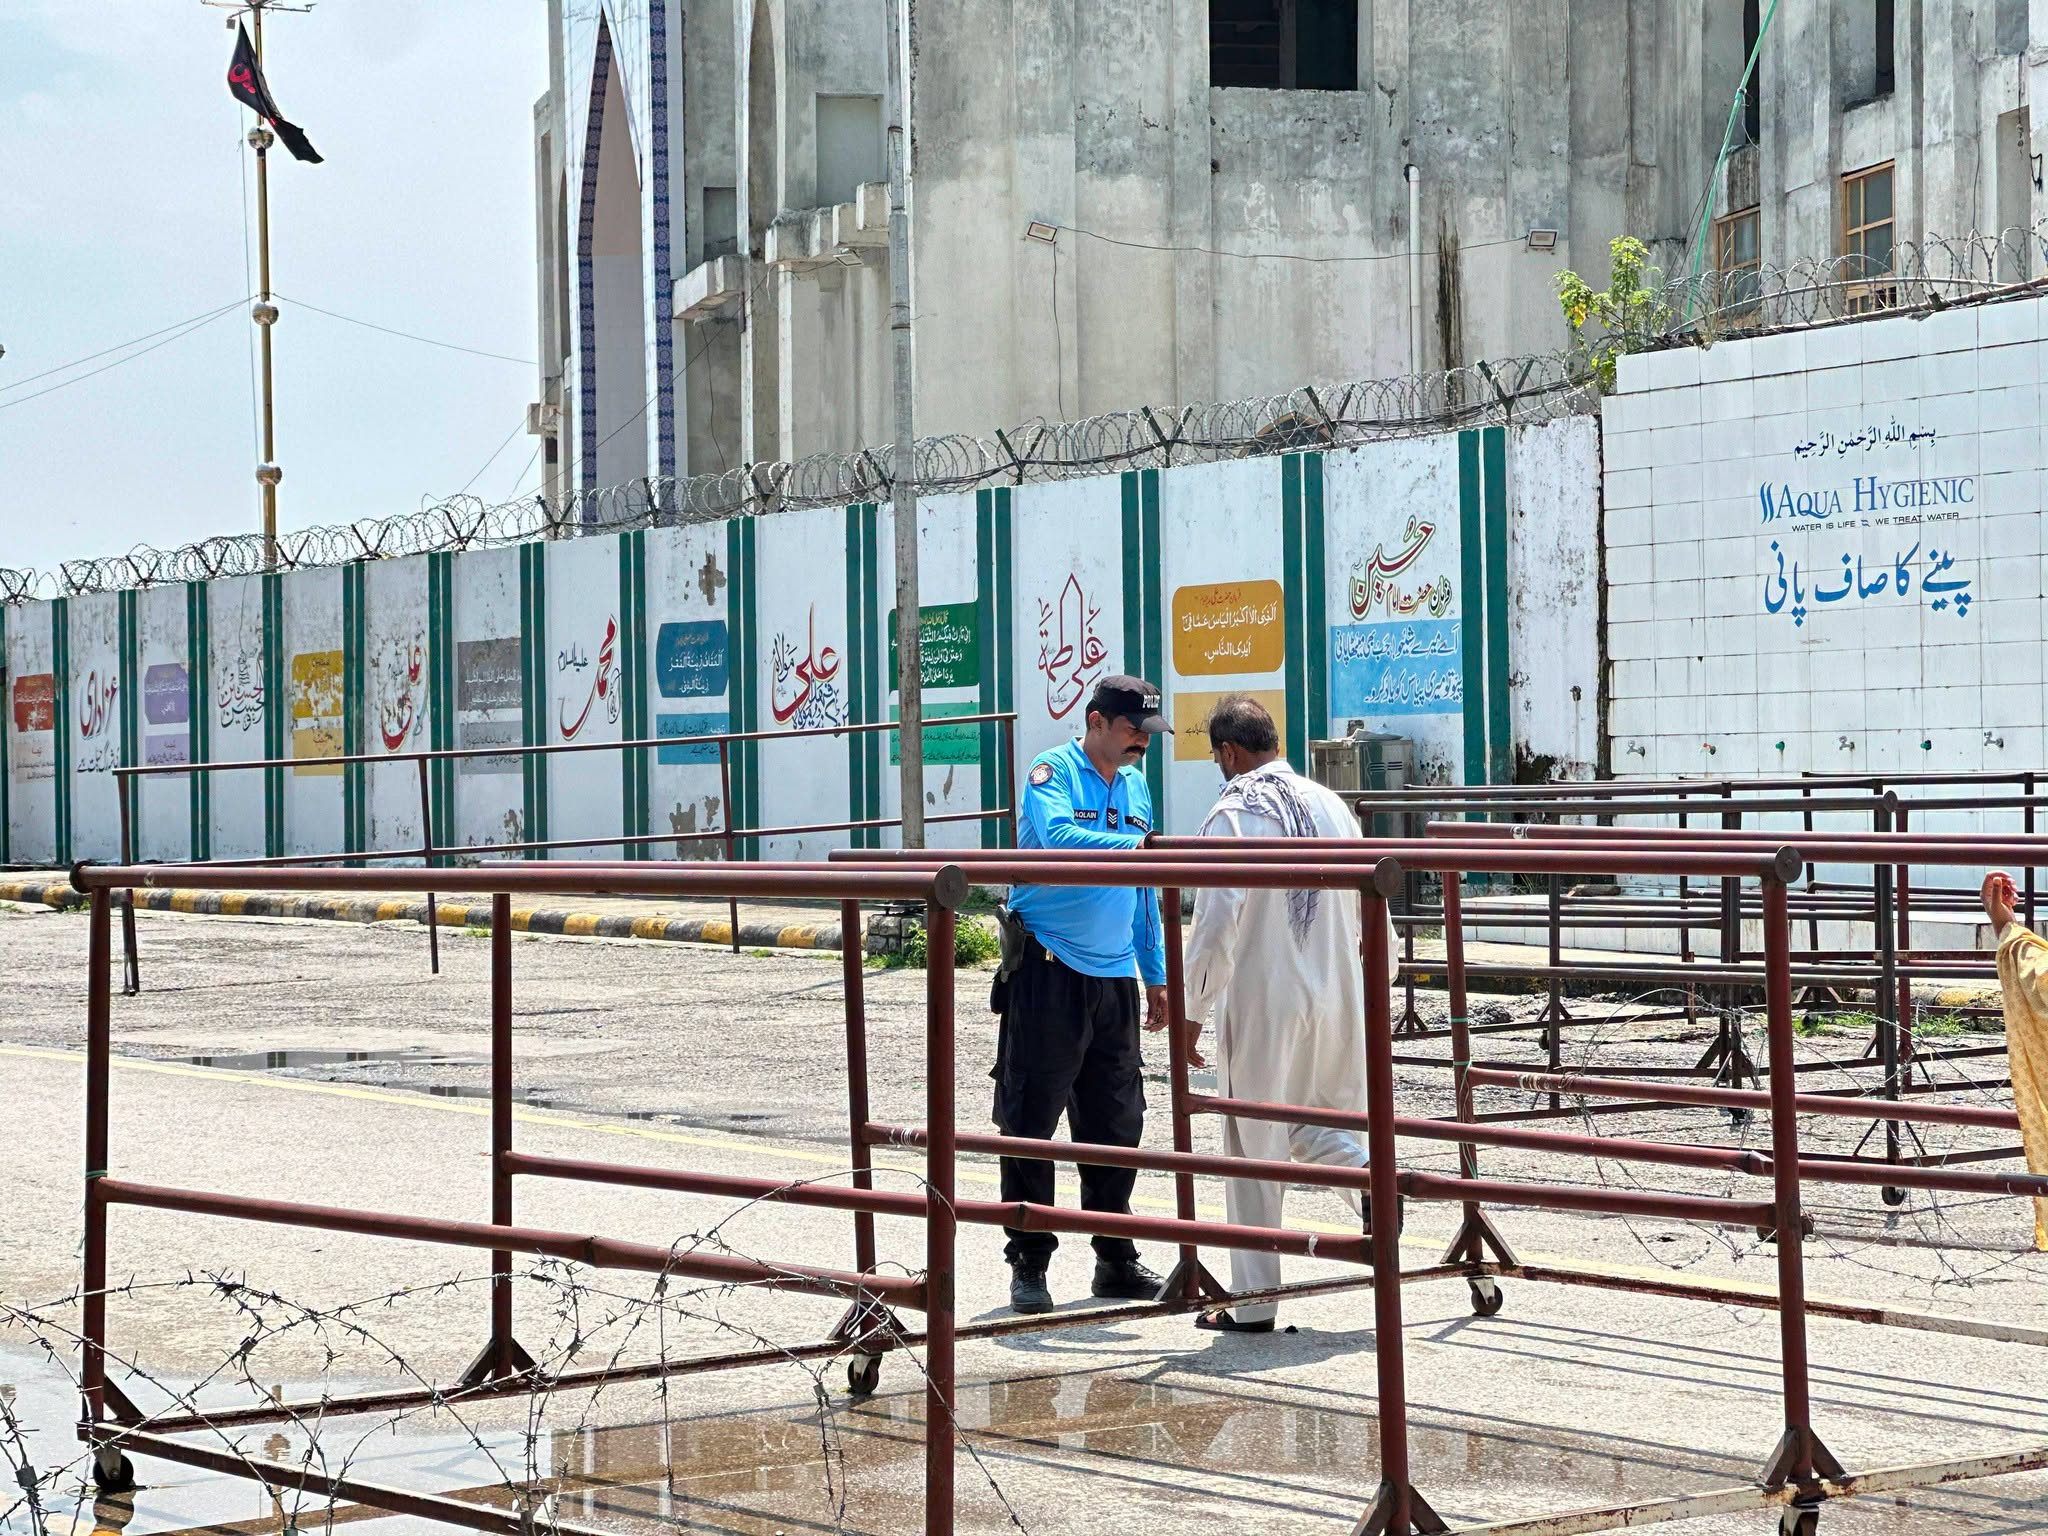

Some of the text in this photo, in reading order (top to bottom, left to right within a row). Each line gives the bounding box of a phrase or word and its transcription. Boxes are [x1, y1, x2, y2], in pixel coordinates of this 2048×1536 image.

[1792, 512, 1960, 532] WATER IS LIFE WE TREAT WATER
[1764, 540, 1808, 628] پانی
[1815, 552, 1888, 603] صاف
[1896, 541, 1920, 597] کا
